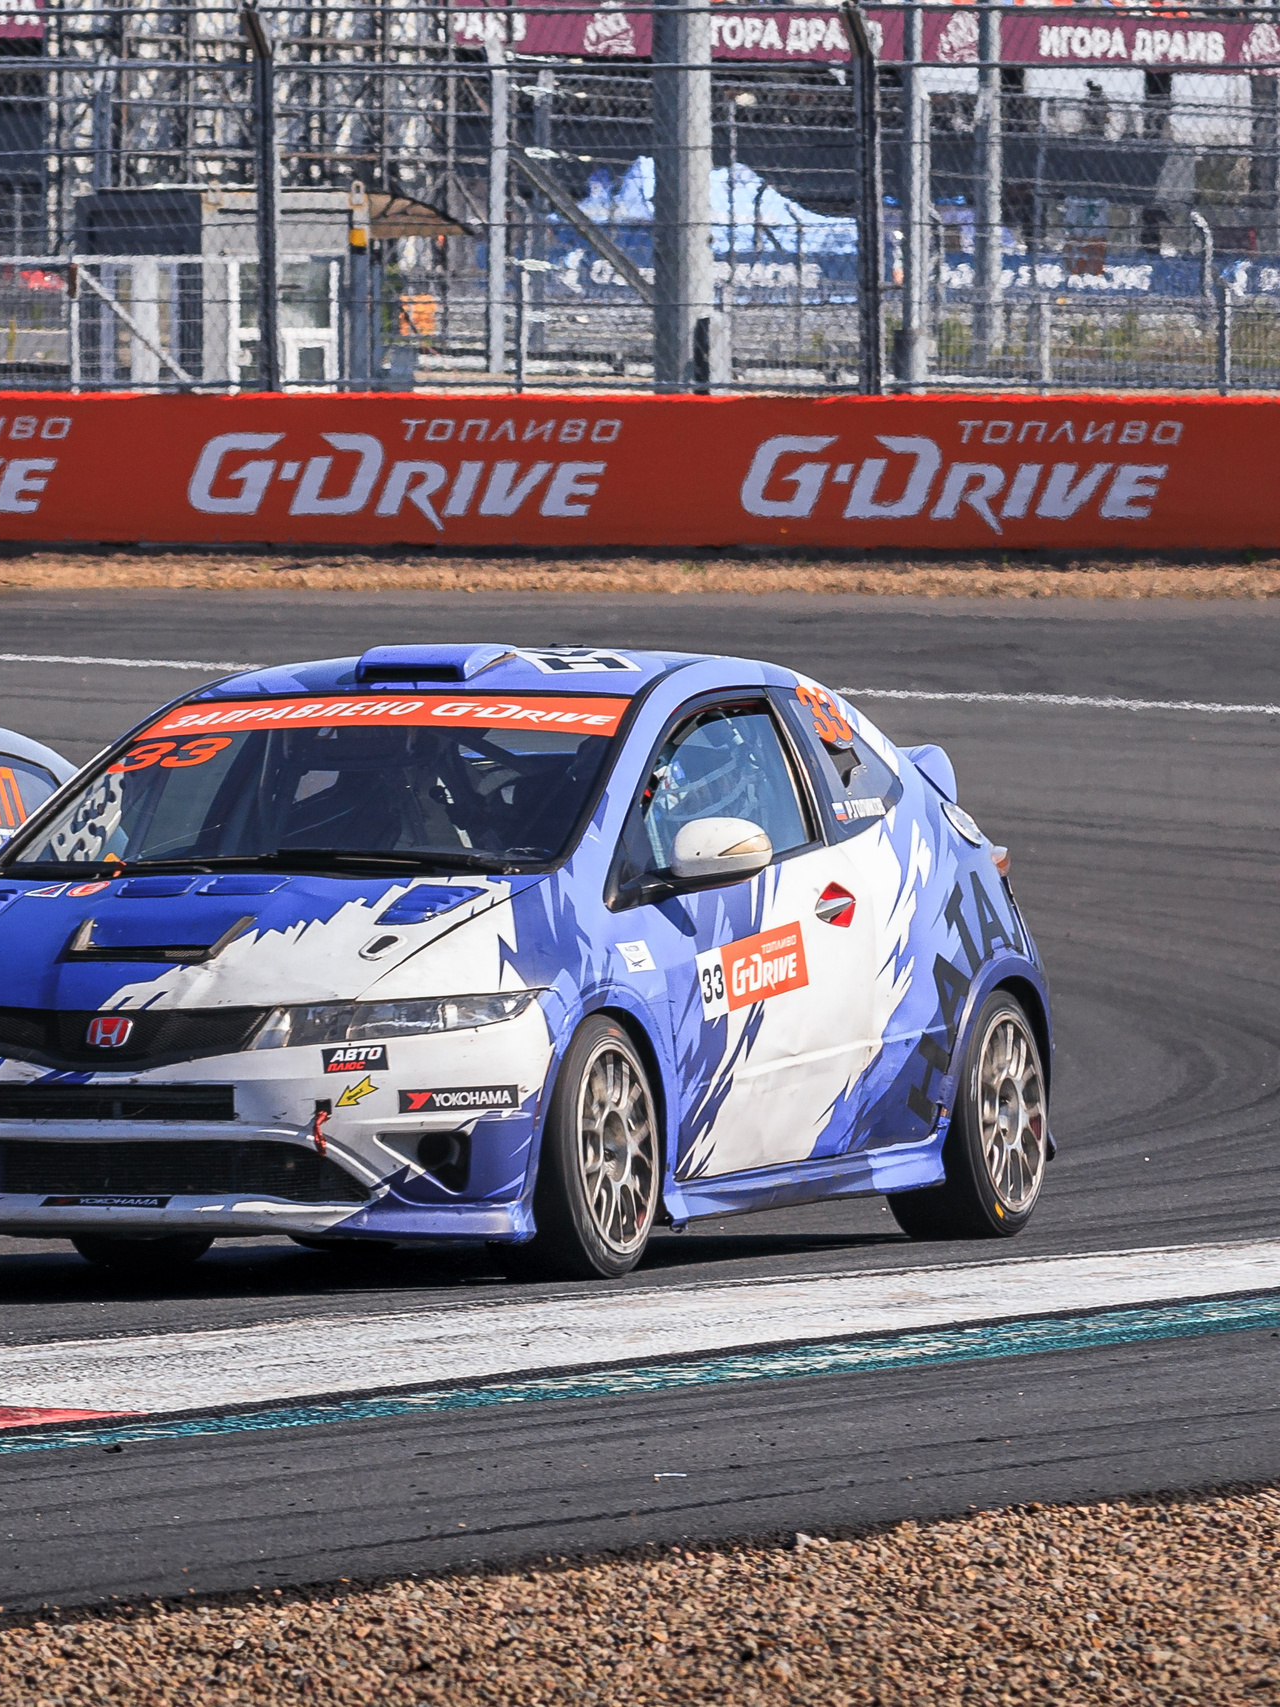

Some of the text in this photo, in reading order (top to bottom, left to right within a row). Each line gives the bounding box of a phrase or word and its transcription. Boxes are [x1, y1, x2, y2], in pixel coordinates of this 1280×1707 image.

[711, 15, 784, 50] ГОРА
[1038, 25, 1226, 63] ИГОРА ДРАЙВ
[402, 418, 622, 444] ТОПЛИВО
[958, 419, 1185, 446] ТОПЛИВО
[163, 701, 424, 730] ЗАПРАВЛЕНО
[795, 685, 853, 743] 33
[107, 738, 232, 774] 33
[761, 935, 797, 954] ТОПЛИВО
[702, 964, 724, 1004] 33
[327, 1061, 366, 1072] ПЛЮС
[330, 1047, 383, 1063] АВТО
[432, 1089, 513, 1108] YOKOHAMA
[80, 1197, 159, 1206] YOKOHAMA
